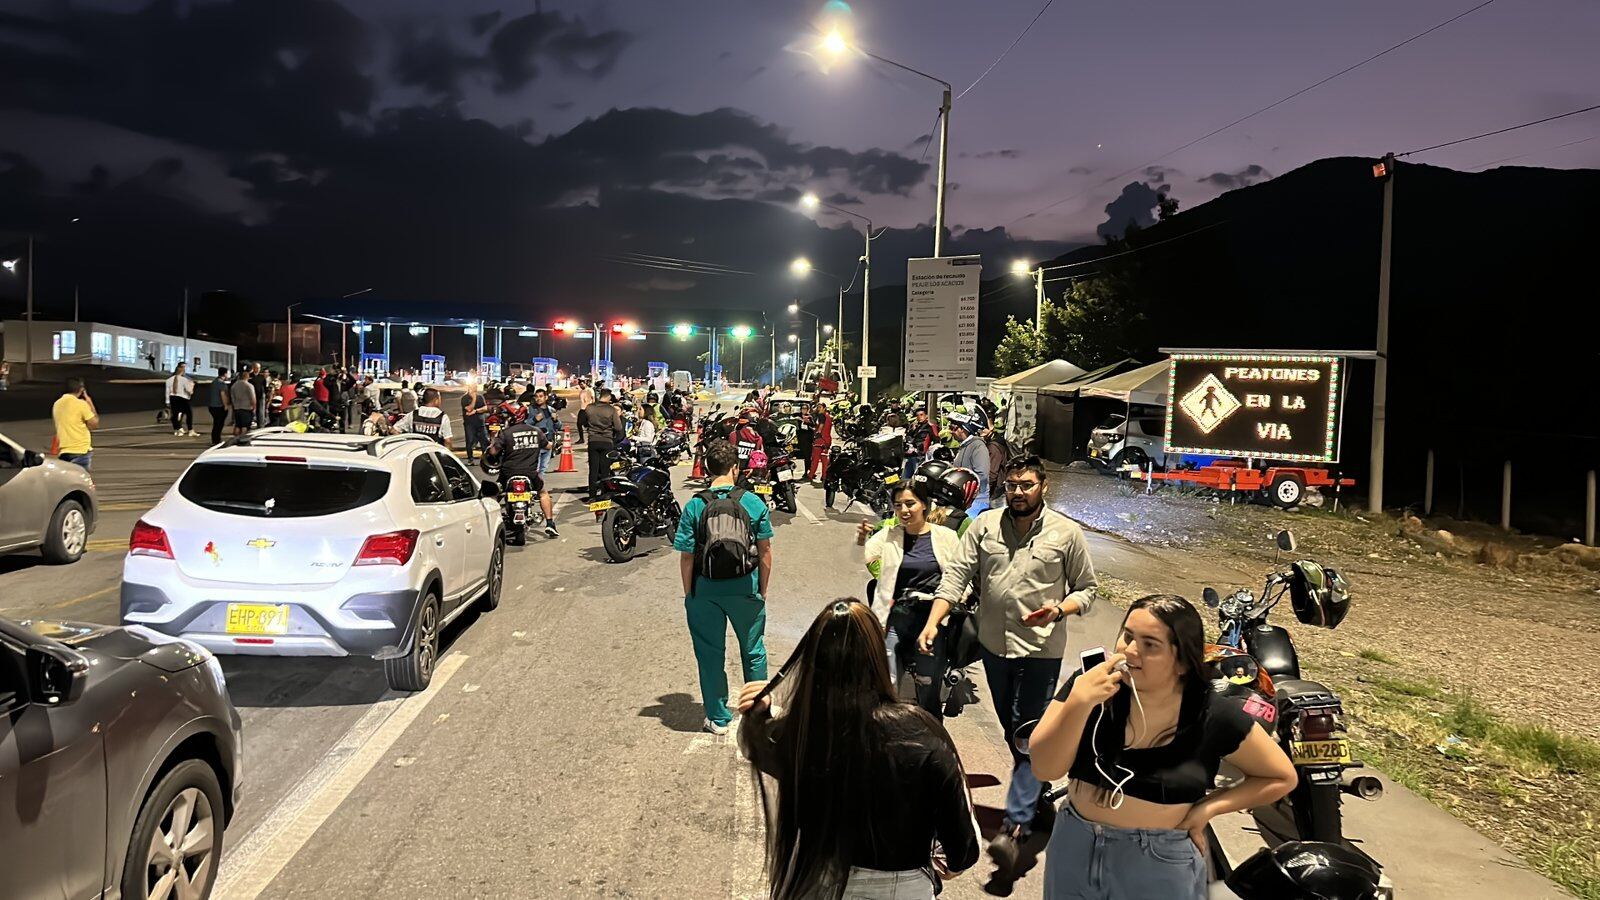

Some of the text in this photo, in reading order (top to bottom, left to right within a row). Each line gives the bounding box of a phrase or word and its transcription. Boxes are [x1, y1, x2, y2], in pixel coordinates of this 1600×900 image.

[1224, 367, 1321, 382] PEATONES
[1246, 394, 1306, 410] EN LA
[1257, 422, 1292, 440] VIA
